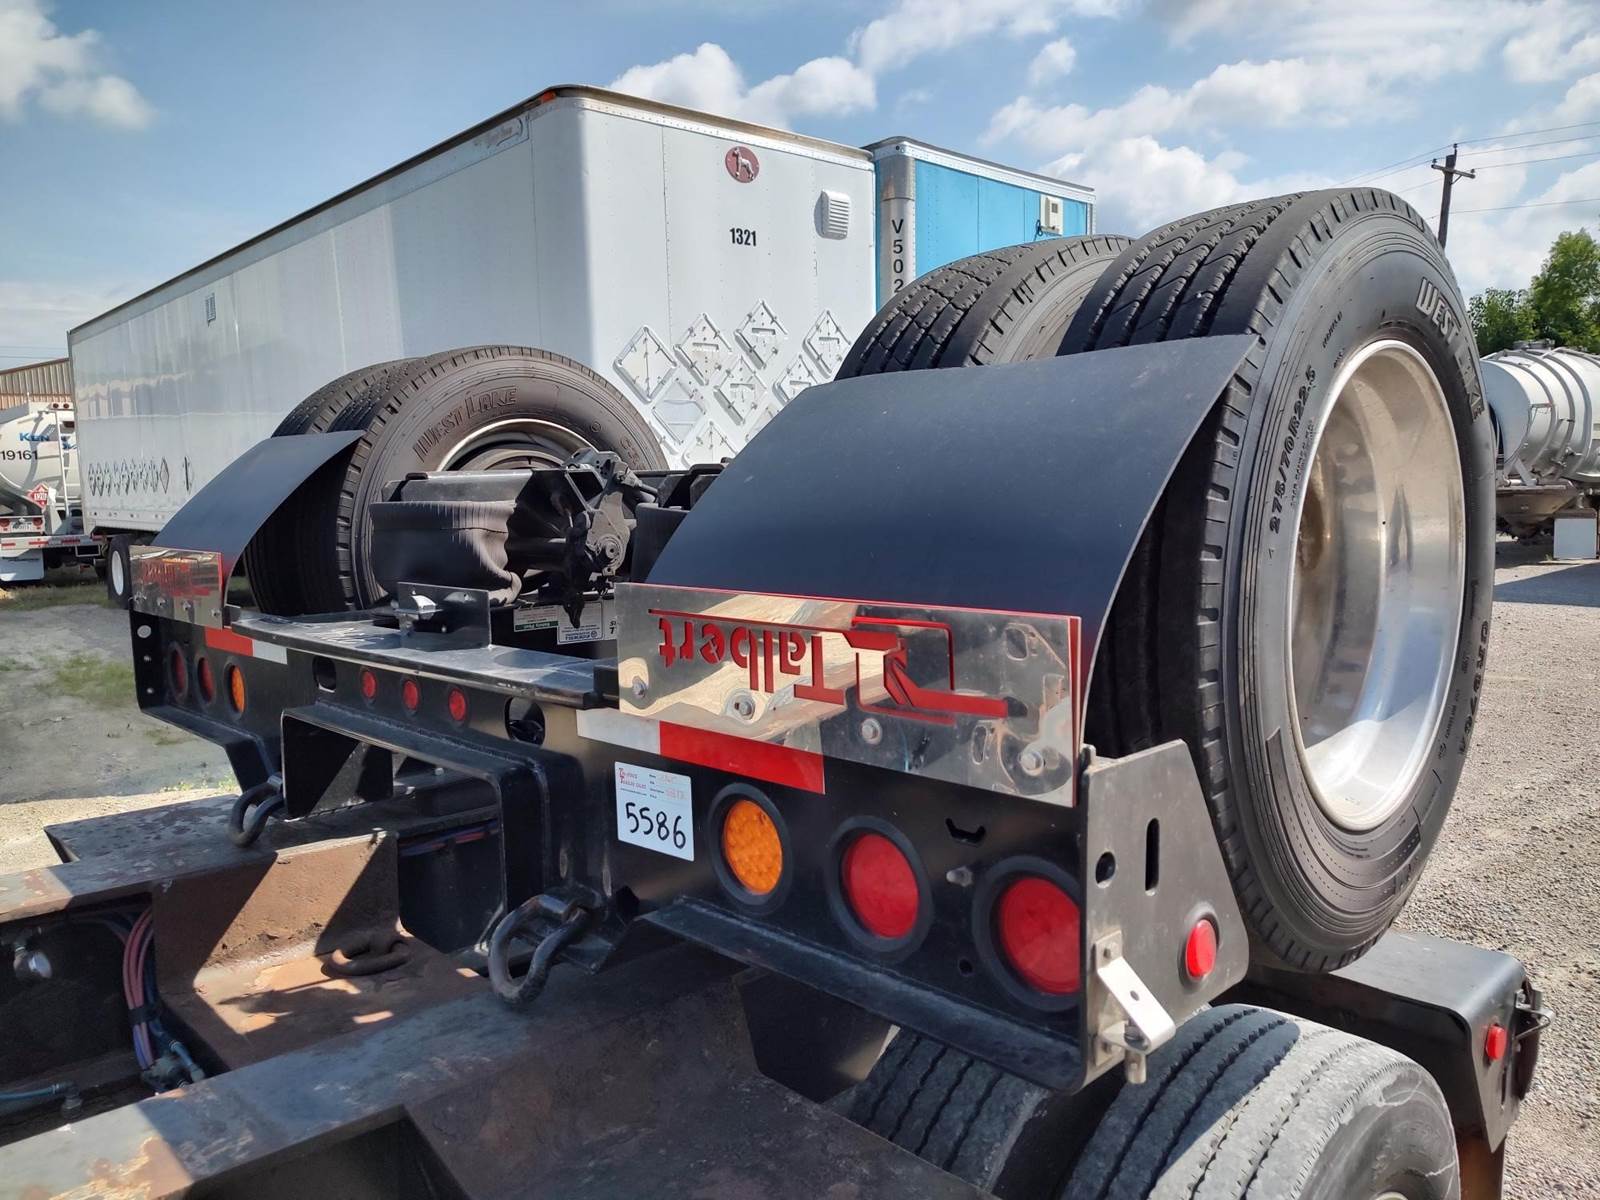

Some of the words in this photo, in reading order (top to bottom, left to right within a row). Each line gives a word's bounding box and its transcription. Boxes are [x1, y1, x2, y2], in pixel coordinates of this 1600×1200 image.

[729, 227, 757, 247] 1321
[1415, 276, 1460, 345] WEST
[0, 449, 39, 461] 19161
[1269, 364, 1317, 535] 275/70R22.5
[658, 617, 846, 706] Talbert
[625, 801, 687, 850] 5586
